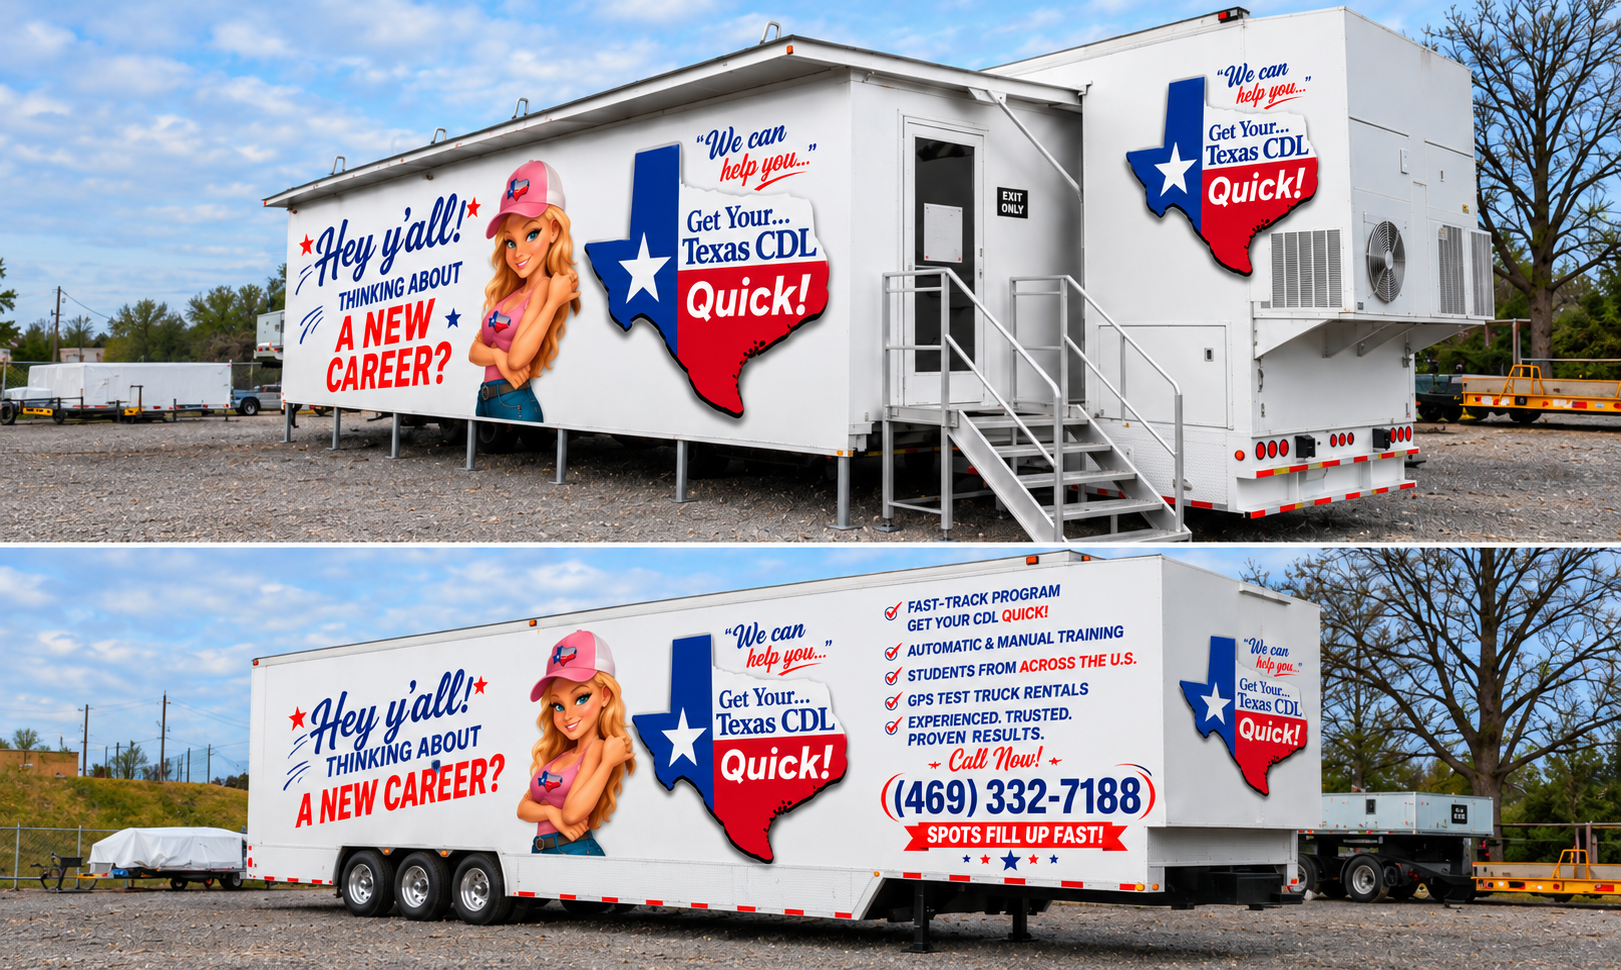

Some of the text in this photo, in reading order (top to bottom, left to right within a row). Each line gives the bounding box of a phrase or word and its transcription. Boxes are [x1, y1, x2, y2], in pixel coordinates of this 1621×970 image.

[1217, 63, 1289, 88] “We can
[1236, 83, 1267, 107] help
[697, 125, 787, 160] “We can
[1209, 120, 1289, 141] Get Your...
[1206, 135, 1309, 165] Texas CDL
[720, 153, 758, 186] help
[1003, 191, 1022, 202] EXIT
[1208, 167, 1306, 207] Quick!
[687, 205, 789, 233] Get Your...
[1002, 204, 1024, 214] ONLY
[315, 193, 466, 287] Hey y’all!
[682, 228, 817, 265] Texas CDL
[339, 261, 463, 311] THINKING ABOUT
[687, 274, 811, 322] Quick!
[334, 298, 436, 352] A NEW
[326, 341, 452, 392] CAREER?
[908, 584, 1061, 613] FAST-TRACK PROGRAM
[907, 605, 1049, 632] GET YOUR CDL QUICK!
[725, 622, 806, 649] “We can
[907, 625, 1124, 657] AUTOMATIC & MANUAL TRAINING
[746, 645, 780, 673] help
[1256, 656, 1274, 673] help
[1270, 647, 1289, 657] can
[908, 652, 1137, 682] STUDENTS FROM ACROSS THE U.S.
[719, 687, 810, 708] Get Your...
[908, 682, 1089, 707] GPS TEST TRUCK RENTALS
[1240, 678, 1290, 697] Get Your...
[310, 669, 474, 755] Hey y’all!
[908, 707, 1072, 728] EXPERIENCED. TRUSTED.
[1238, 692, 1302, 717] Texas CDL
[716, 707, 835, 735] Texas CDL
[1239, 717, 1301, 746] Quick!
[908, 727, 1044, 746] PROVEN RESULTS.
[326, 725, 482, 778] THINKING ABOUT
[721, 744, 833, 784] Quick!
[949, 746, 1043, 772] Call Now!
[295, 753, 505, 828] A NEW CAREER?
[895, 777, 1141, 818] (469) 332-7188
[927, 826, 1104, 844] SPOTS FILL UP FAST!
